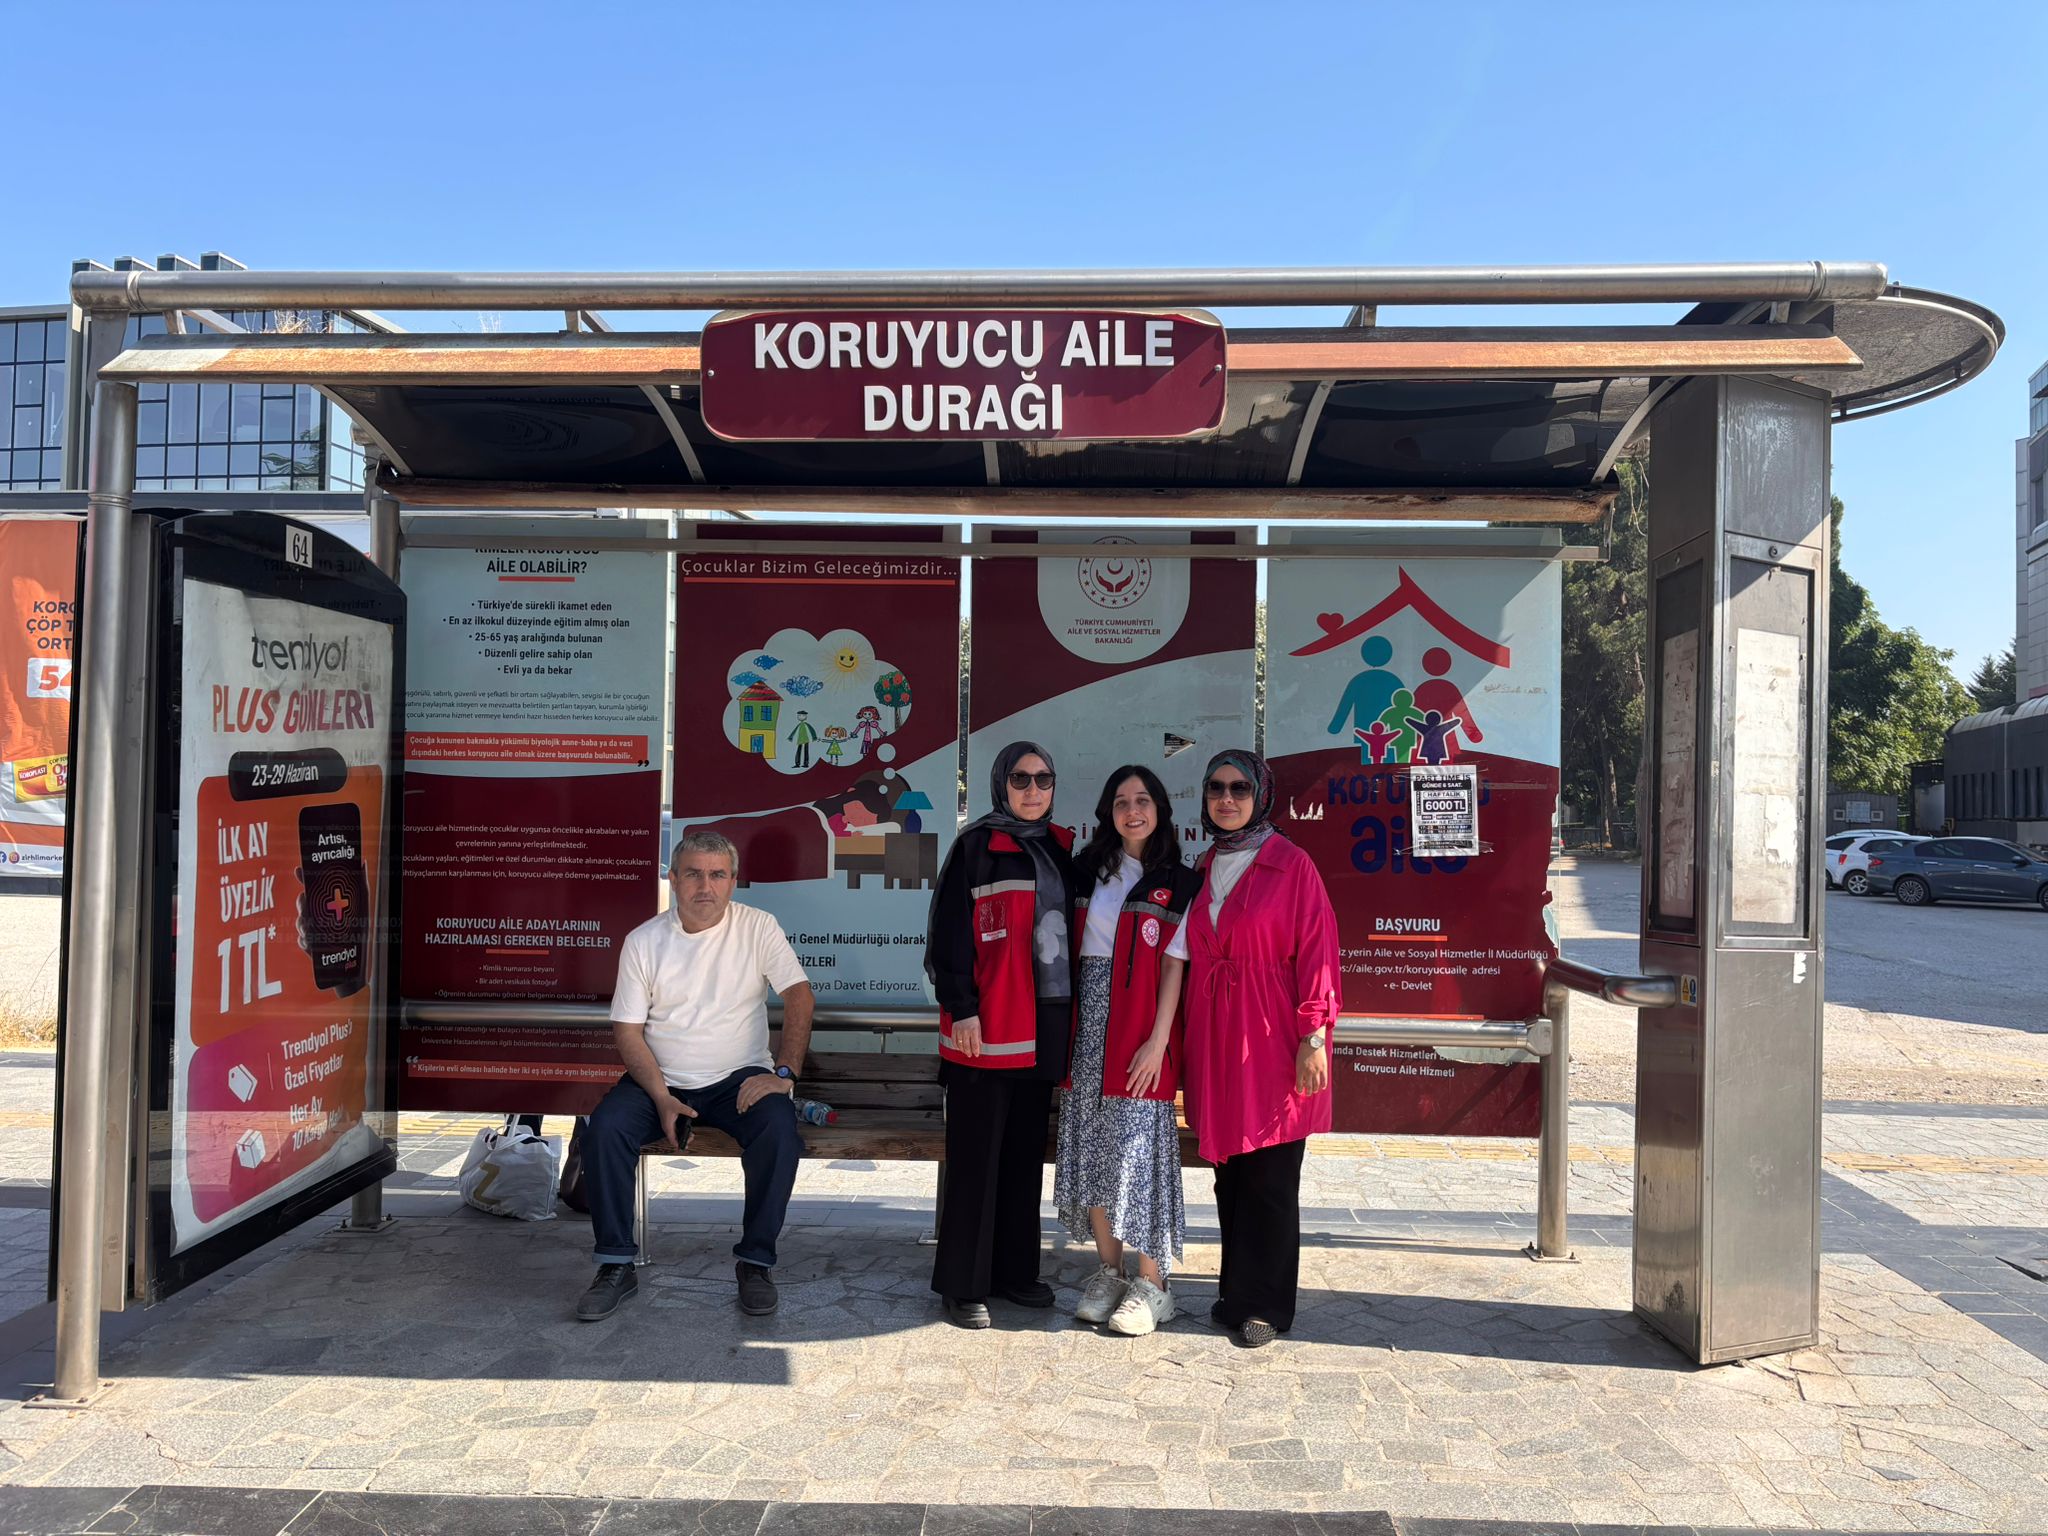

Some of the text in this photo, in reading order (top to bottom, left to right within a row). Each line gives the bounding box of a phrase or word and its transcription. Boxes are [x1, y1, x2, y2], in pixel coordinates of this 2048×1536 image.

[754, 320, 1043, 369] KORUYUCU
[864, 370, 1062, 431] DURAĞI
[292, 533, 308, 564] 64
[487, 558, 587, 574] AİLE OLABİLİR?
[682, 559, 956, 577] Çocuklar Bizim Geleceğimizdir...
[478, 600, 611, 612] Türkiye'de sürekli ikamet eden
[26, 616, 62, 634] ÇÖP
[448, 615, 629, 628] En az ilkokul düzeyinde eğitim almış olan
[1105, 618, 1153, 626] CUMHURİYETİ
[474, 632, 602, 644] 25-65 yaş aralığında bulunan
[484, 648, 592, 660] Düzenli gelire sahip olan
[503, 664, 572, 676] Evli ya da bekar
[212, 684, 280, 734] PLUS
[252, 763, 319, 786] 23-29 Haziran
[1425, 801, 1465, 811] 6000 TL
[218, 818, 268, 865] İLK AY
[318, 832, 347, 847] Artısı,
[312, 846, 355, 864] ayrıcalığı
[220, 868, 275, 923] ÜYELİK
[436, 917, 600, 931] KORUYUCU AİLE ADAYLARININ
[1376, 918, 1440, 934] BAŞVURU
[425, 933, 610, 947] HAZIRLAMASI GEREKEN BELGELER
[799, 932, 829, 944] Genel
[832, 933, 889, 947] Müdürlüğü
[892, 933, 926, 945] olarak
[1348, 948, 1371, 958] yerin
[1374, 948, 1392, 957] Aile
[1407, 948, 1437, 959] Sosyal
[1440, 948, 1486, 958] Hizmetler
[834, 980, 866, 990] Davet
[869, 979, 919, 993] Ediyoruz.
[1401, 980, 1432, 990] Devlet
[281, 1028, 328, 1060] Trendyol
[1356, 1047, 1386, 1057] Destek
[1389, 1048, 1437, 1060] Hizmetleri
[284, 1053, 344, 1091] Özel Fiyatlar
[1354, 1062, 1454, 1077] Koruyucu Aile Hizmeti
[290, 1101, 309, 1125] Her
[311, 1096, 323, 1116] Ay
